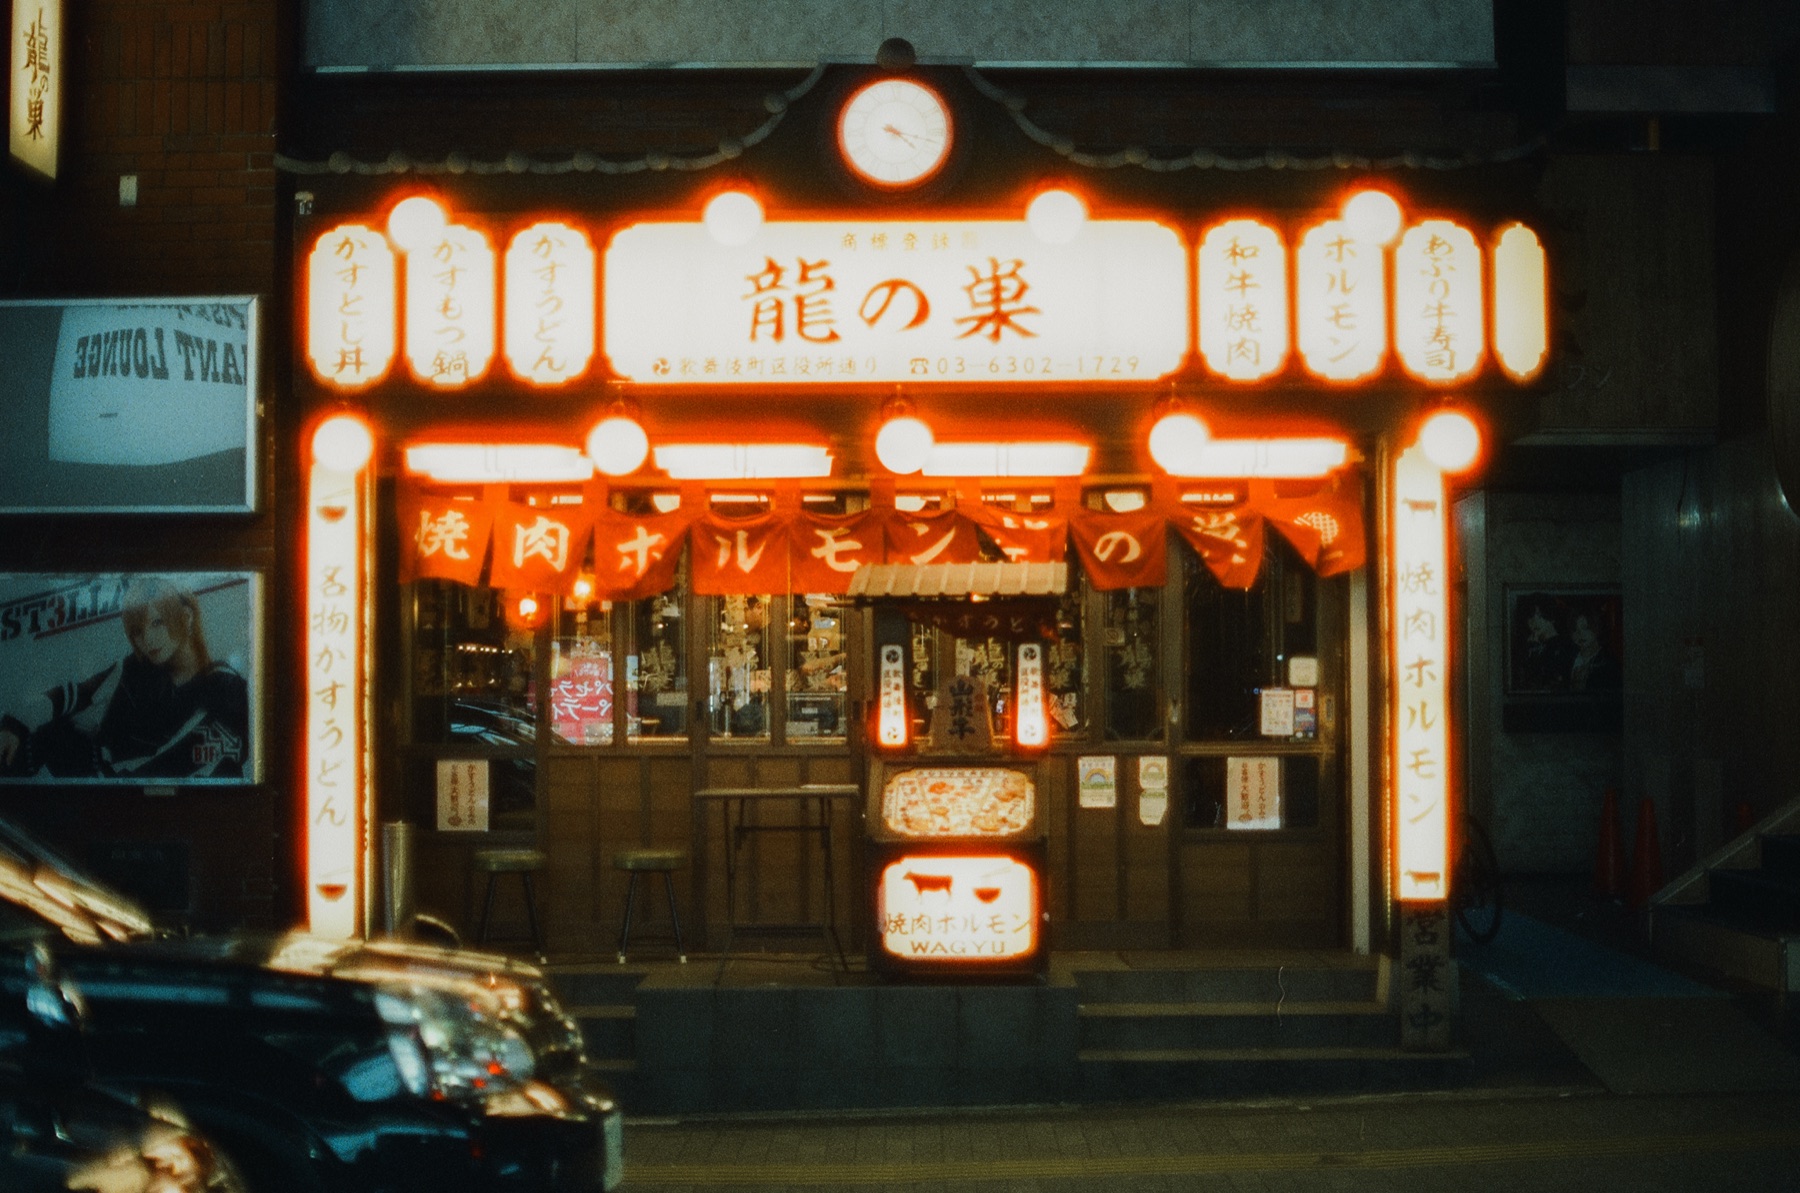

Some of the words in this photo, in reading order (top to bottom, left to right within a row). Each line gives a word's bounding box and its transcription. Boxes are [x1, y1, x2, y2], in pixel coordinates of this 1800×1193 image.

[23, 8, 50, 140] 龍の巣
[432, 238, 469, 377] かすもつ鍋
[531, 234, 567, 373] かすうどん
[740, 256, 1043, 345] 龍の巣
[1222, 235, 1262, 368] 和牛焼肉
[1326, 233, 1360, 364] ホルモン
[679, 355, 878, 376] 歌舞伎町区役所通り
[936, 355, 1140, 375] 03-6302-1729
[311, 564, 351, 829] 名物かすうどん
[1400, 560, 1438, 826] 焼肉ホルモン
[885, 912, 1031, 935] 焼肉ホルモン
[911, 940, 1006, 954] WAGYU
